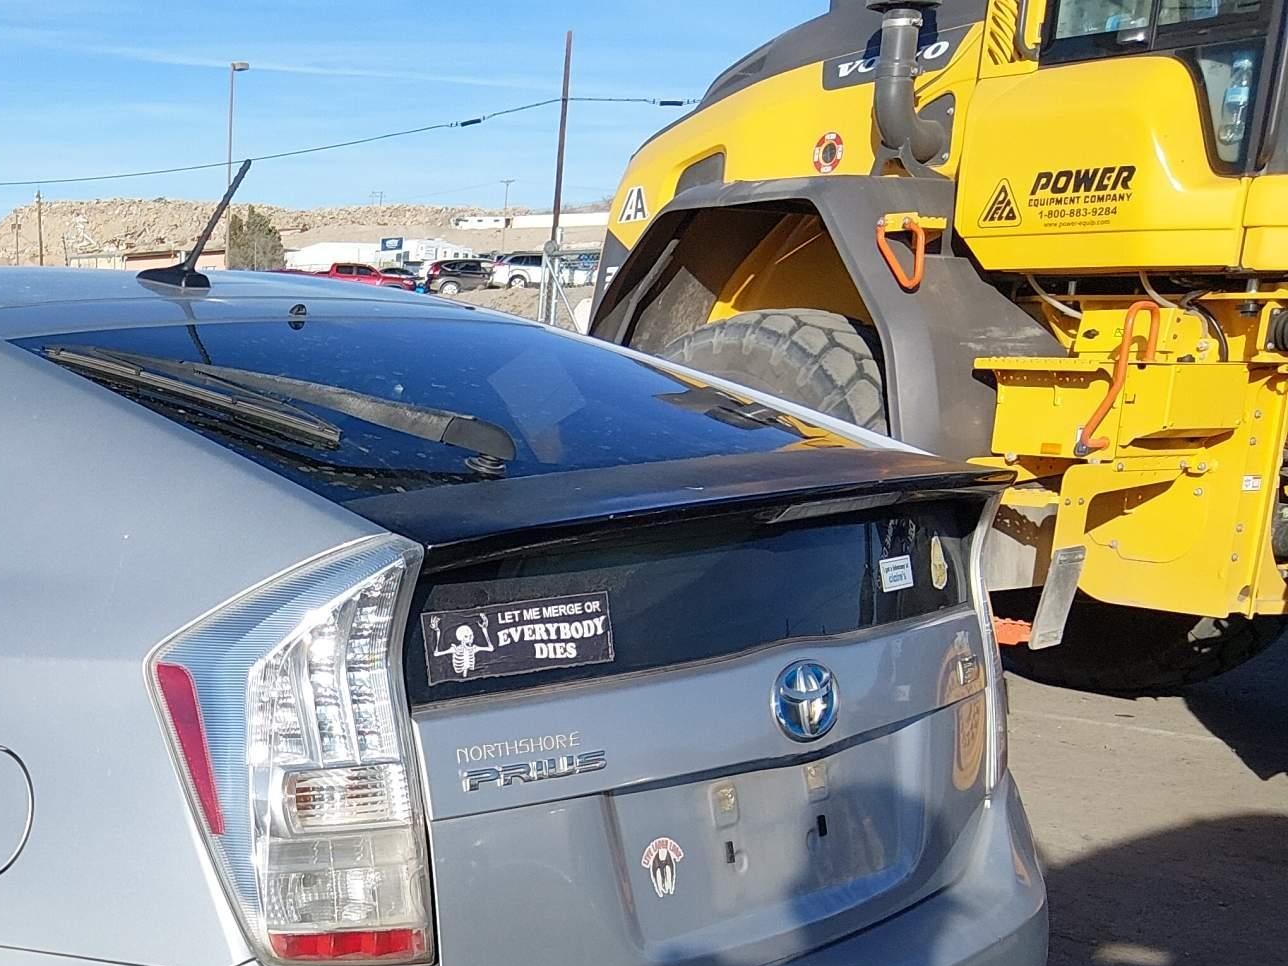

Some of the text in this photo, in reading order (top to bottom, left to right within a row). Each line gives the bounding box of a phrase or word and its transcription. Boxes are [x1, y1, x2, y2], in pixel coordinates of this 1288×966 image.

[838, 41, 949, 78] VOO
[1029, 165, 1136, 196] POWER
[1028, 193, 1132, 207] EQUIPMENT COMPANY
[1038, 207, 1117, 219] 1-800-883-9284
[498, 601, 601, 624] LET ME MERGE OR
[497, 616, 606, 646] EVERYBODY
[534, 643, 577, 658] DIES
[456, 731, 581, 763] NORTHSHORE
[462, 750, 607, 792] PRIUS
